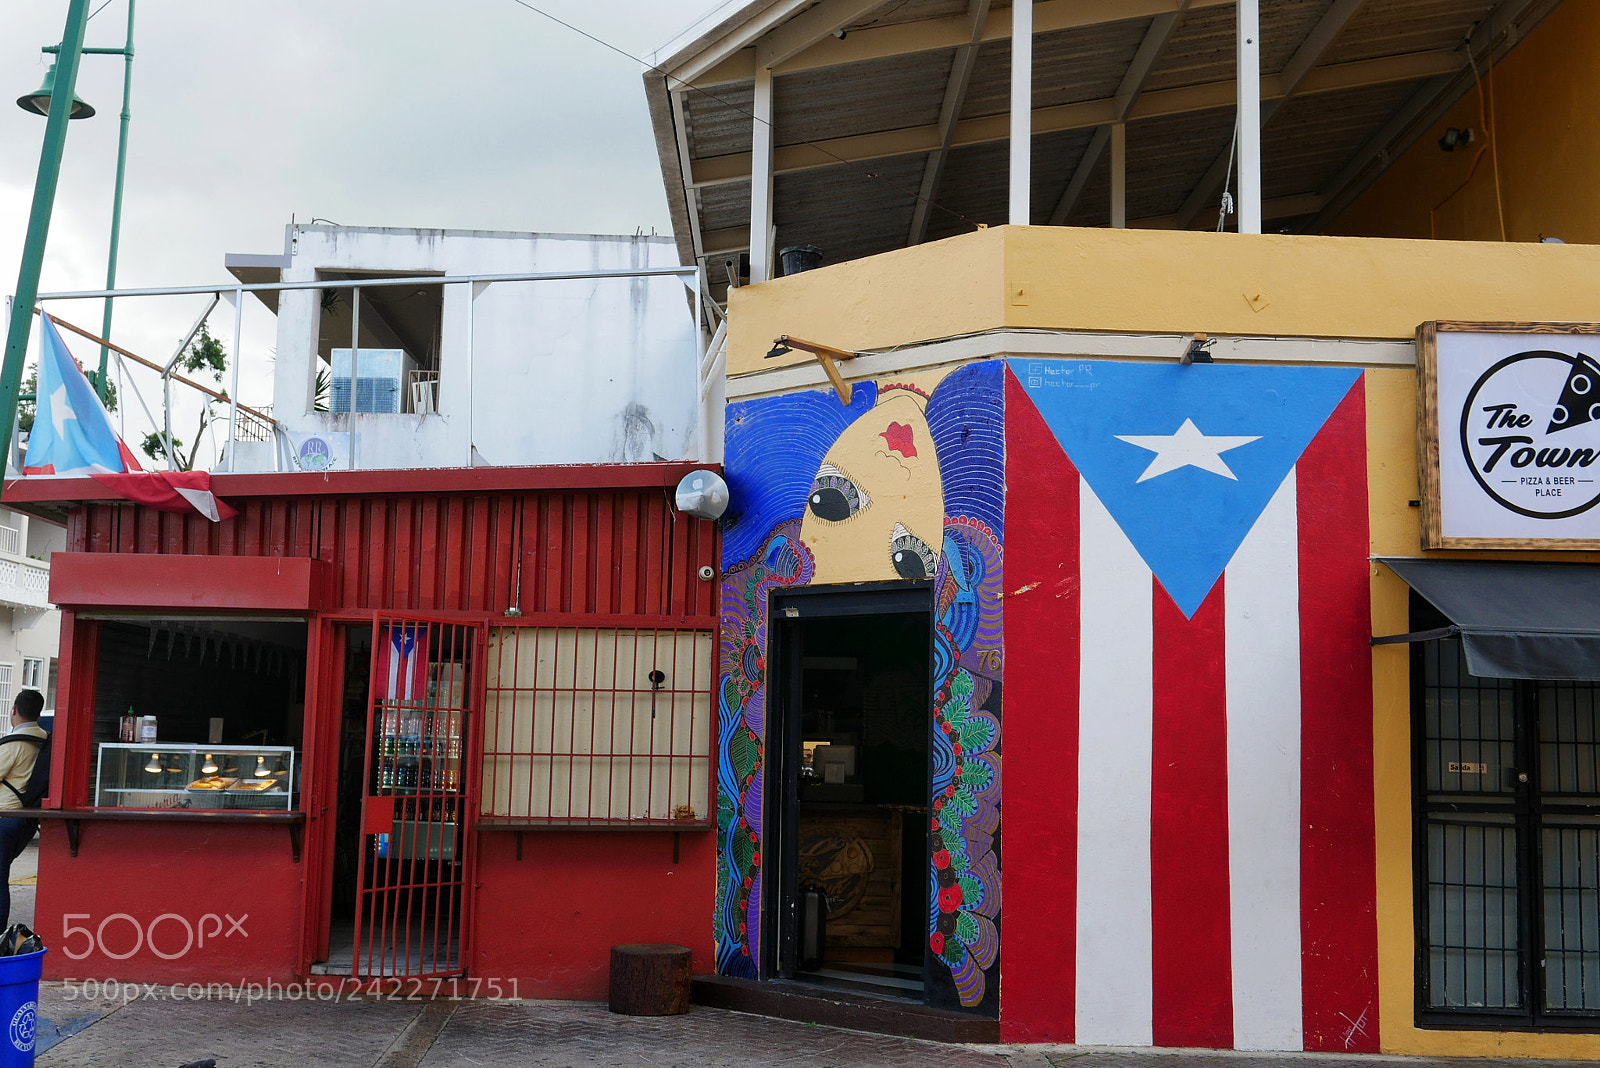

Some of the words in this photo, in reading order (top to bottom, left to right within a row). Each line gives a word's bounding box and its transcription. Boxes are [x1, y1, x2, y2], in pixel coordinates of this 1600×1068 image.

[1482, 403, 1533, 430] The
[1478, 435, 1600, 474] Town
[1520, 477, 1543, 486] PIZZA
[1545, 477, 1551, 485] &
[1553, 476, 1575, 486] BEER
[1535, 488, 1562, 497] PLACE
[977, 649, 1001, 670] 76
